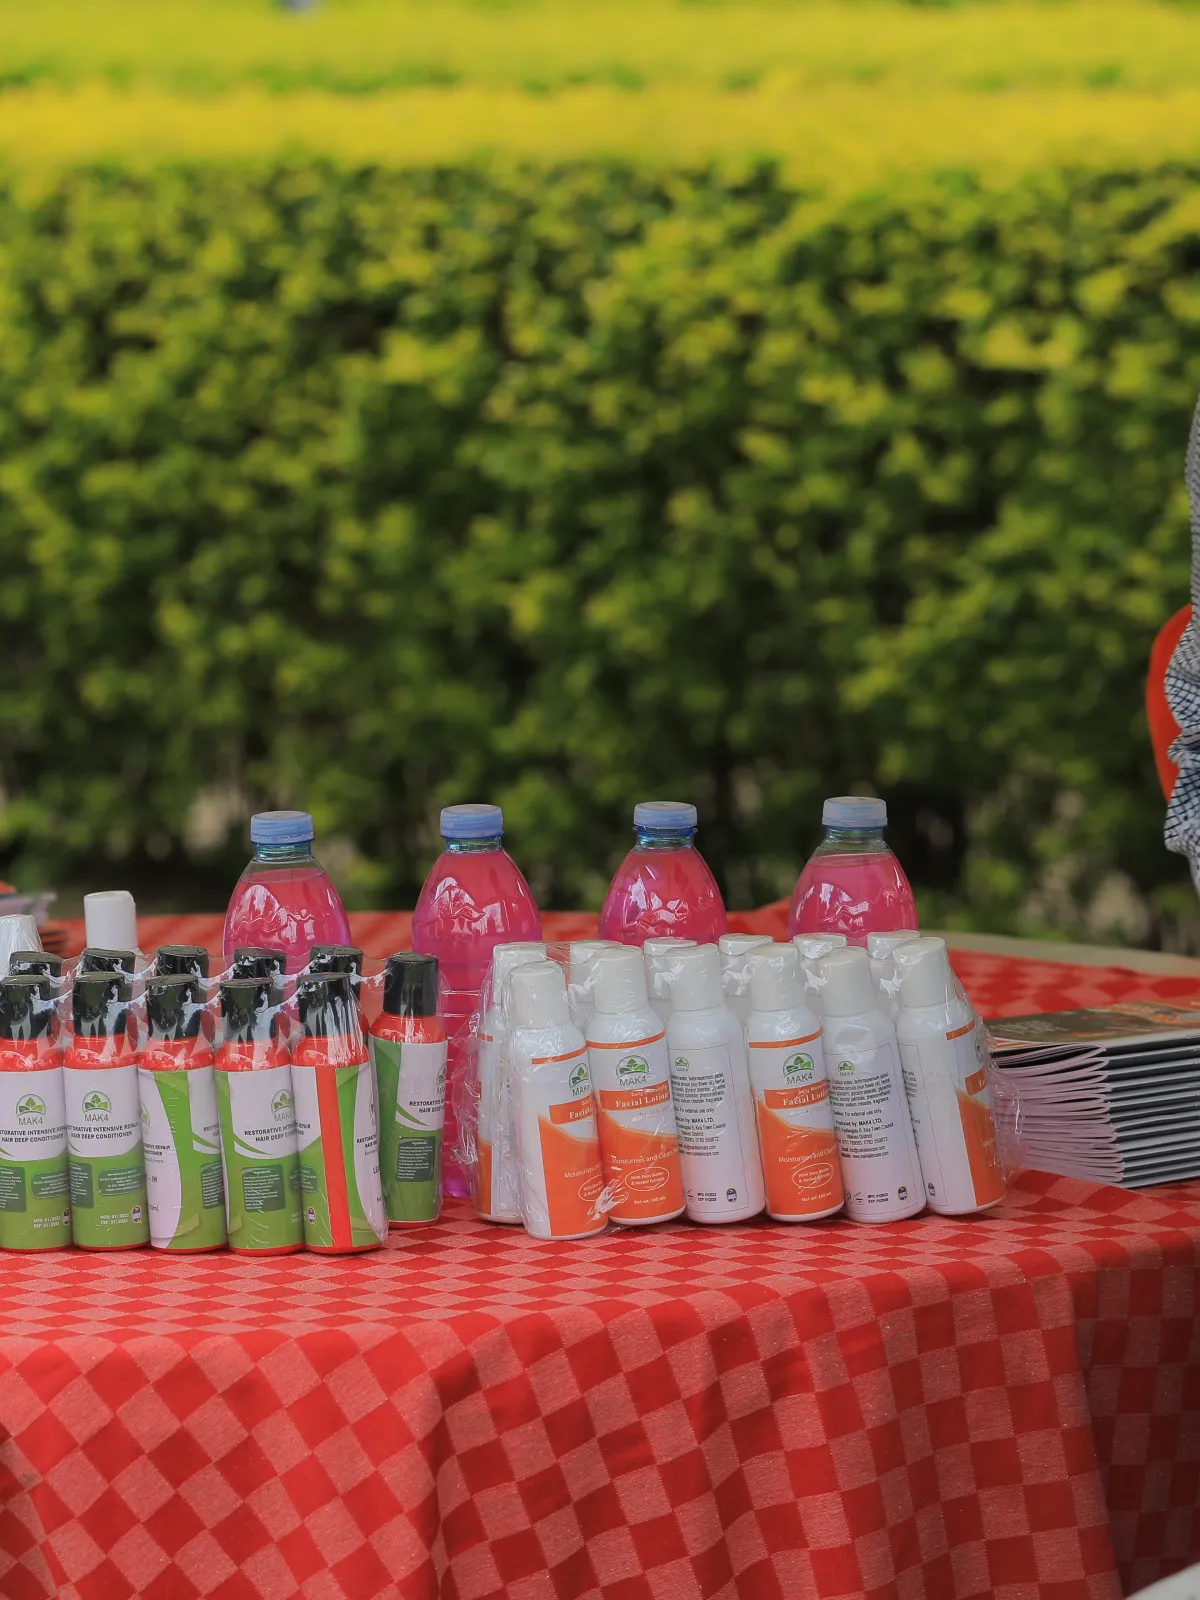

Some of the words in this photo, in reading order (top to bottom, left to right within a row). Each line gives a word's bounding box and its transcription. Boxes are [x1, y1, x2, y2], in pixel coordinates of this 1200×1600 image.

[619, 1075, 647, 1087] MAK4
[786, 1072, 813, 1085] MAK4
[615, 1098, 642, 1108] Facial
[645, 1092, 669, 1104] Lotion
[782, 1094, 809, 1106] Facial
[18, 1117, 43, 1126] MAK4
[84, 1113, 109, 1122] MAK4
[27, 1127, 56, 1136] INTENSIVE
[95, 1131, 133, 1139] CONDITIONER
[244, 1126, 282, 1136] RESTORATIVE
[29, 1133, 64, 1143] CONDITIONER
